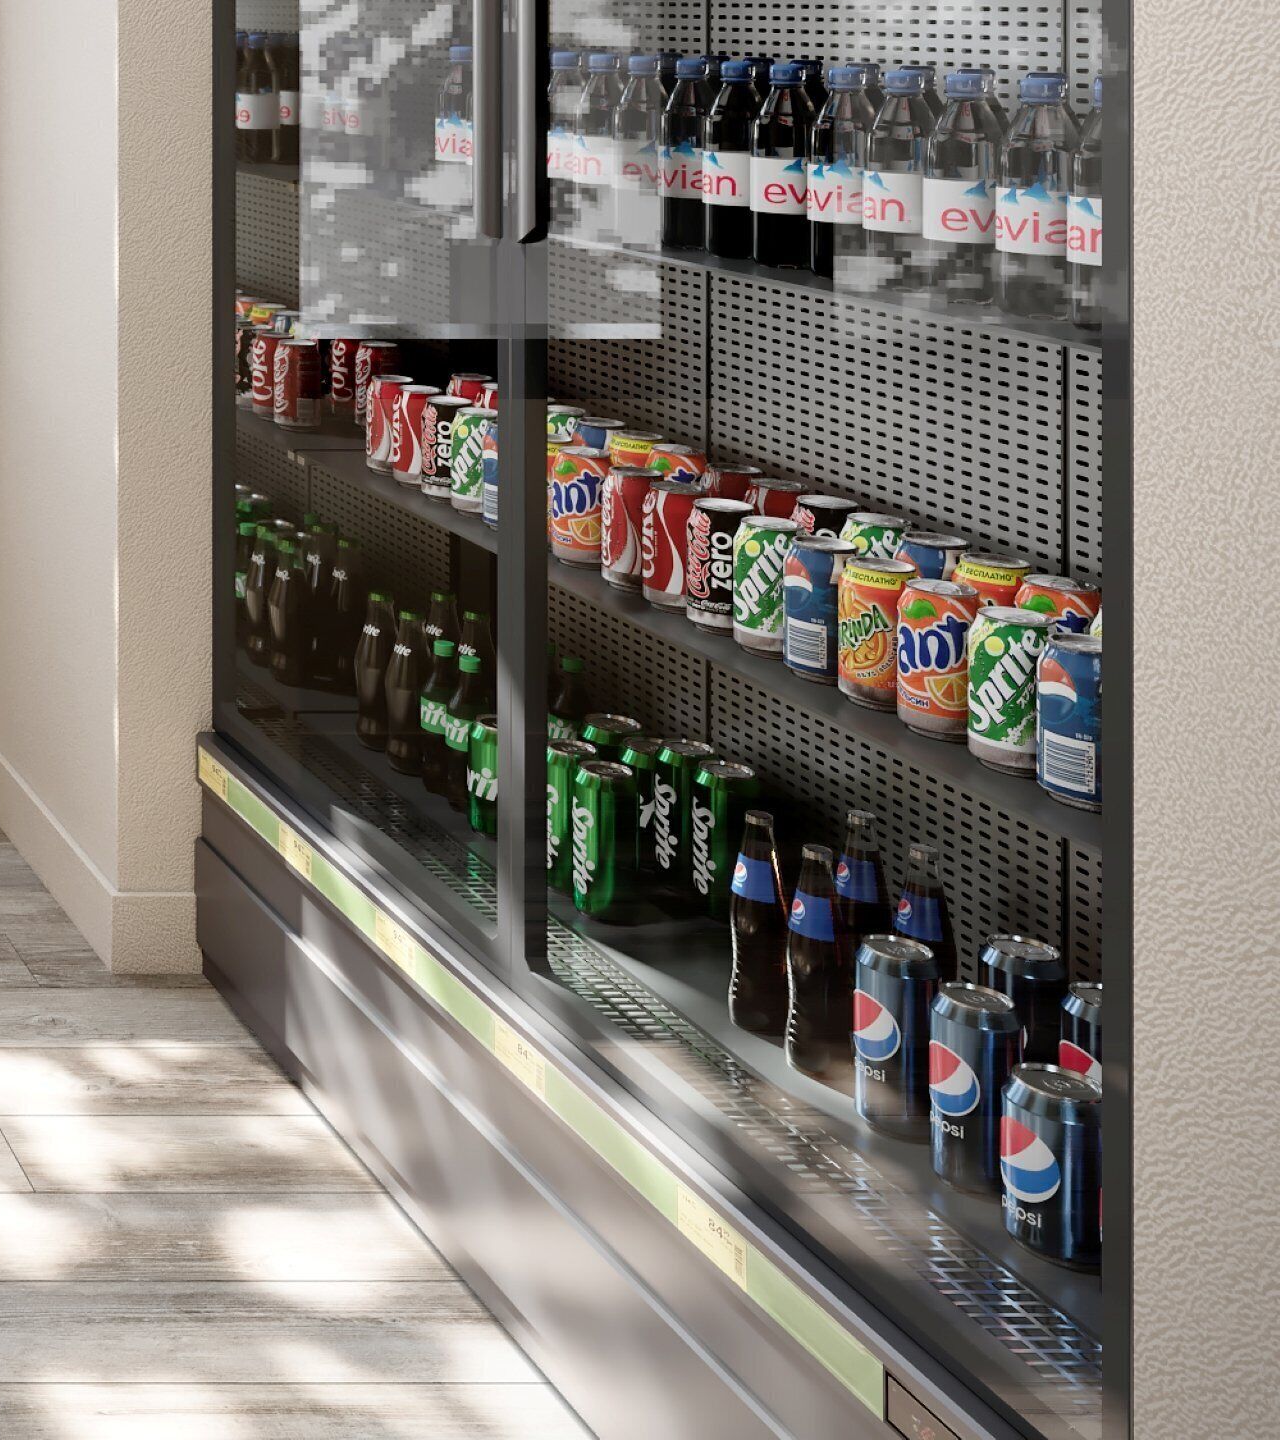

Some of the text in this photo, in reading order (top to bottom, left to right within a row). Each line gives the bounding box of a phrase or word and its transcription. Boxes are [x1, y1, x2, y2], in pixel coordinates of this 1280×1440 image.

[436, 420, 452, 468] zero
[710, 531, 733, 591] zero
[968, 628, 1044, 733] Sprite
[571, 795, 596, 895] Sprite
[652, 772, 678, 870] Sprite
[691, 795, 717, 896] Sprite
[1001, 1194, 1042, 1228] pepsi
